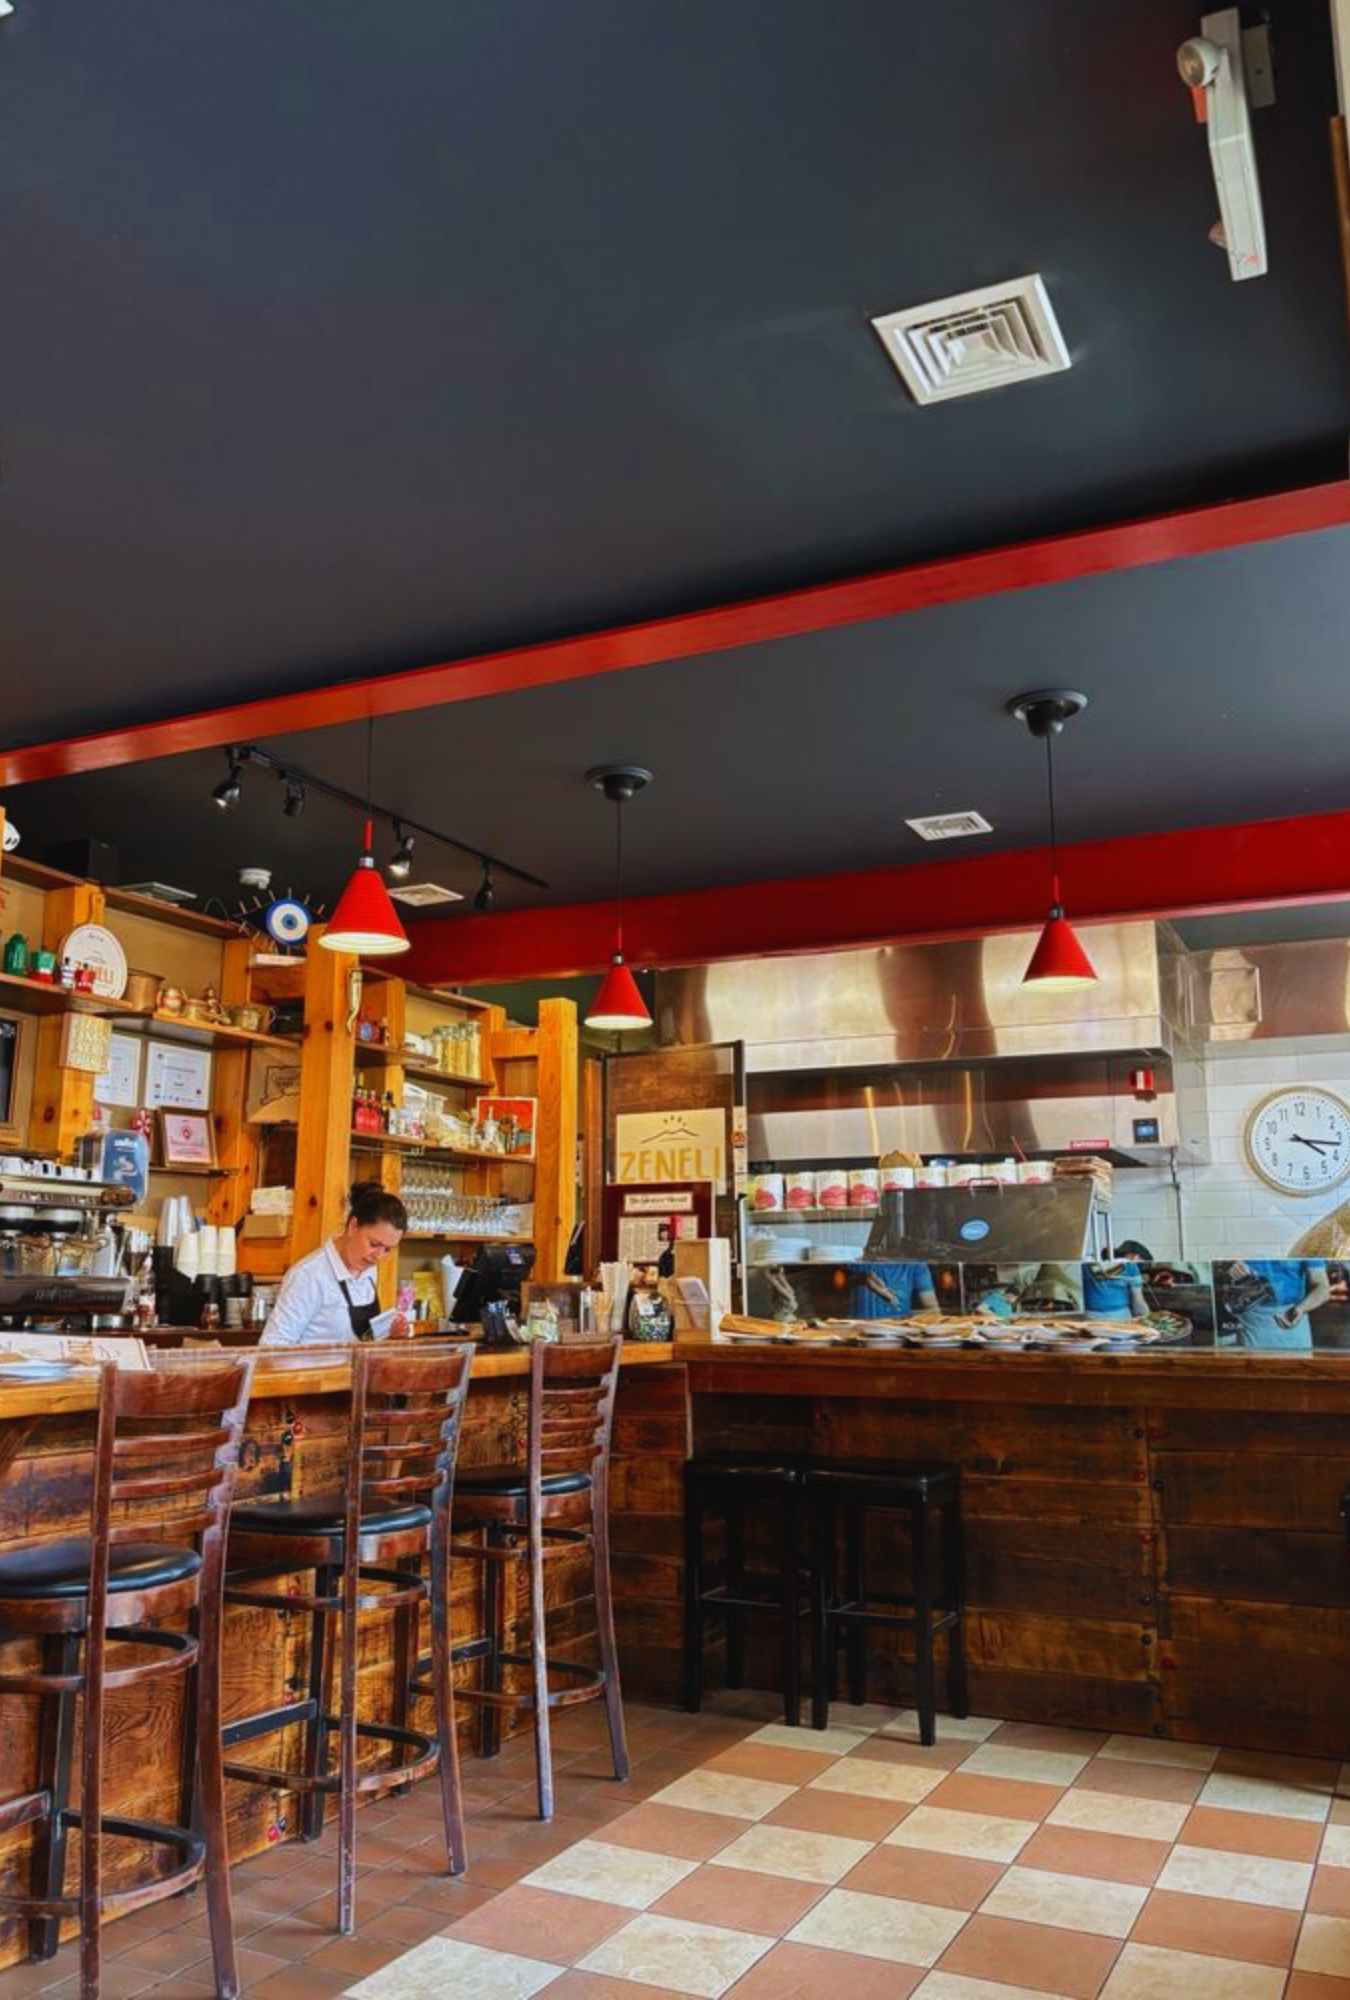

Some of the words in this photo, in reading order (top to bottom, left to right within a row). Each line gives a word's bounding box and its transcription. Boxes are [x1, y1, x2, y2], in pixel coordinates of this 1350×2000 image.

[1280, 1108, 1288, 1121] 11
[1294, 1102, 1305, 1116] 12
[1266, 1120, 1278, 1135] 10
[1328, 1115, 1335, 1130] 2
[1332, 1149, 1339, 1161] 4
[619, 1147, 720, 1184] ZENELI
[1287, 1162, 1293, 1177] 7
[1320, 1160, 1328, 1175] 5
